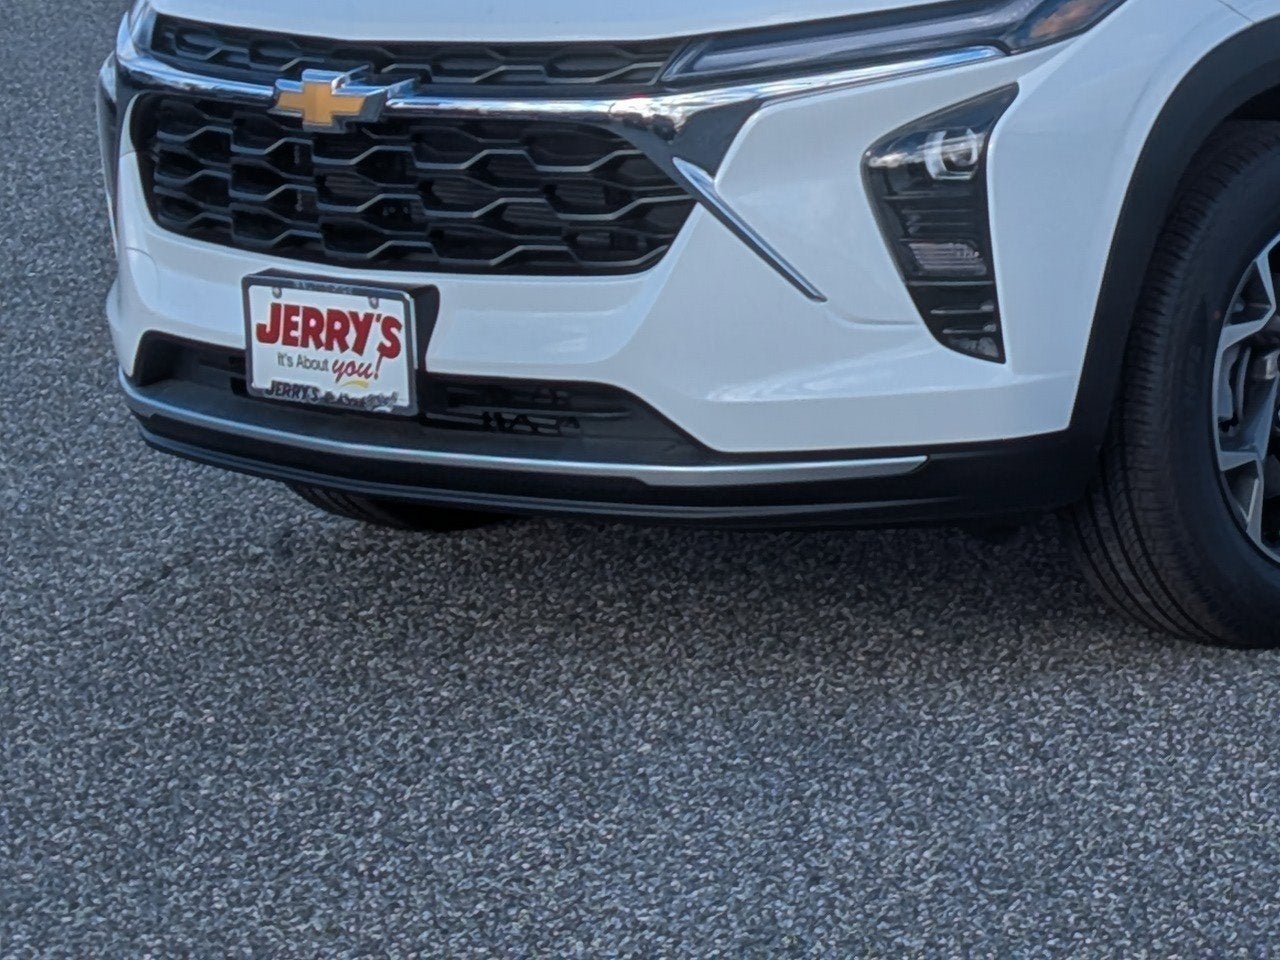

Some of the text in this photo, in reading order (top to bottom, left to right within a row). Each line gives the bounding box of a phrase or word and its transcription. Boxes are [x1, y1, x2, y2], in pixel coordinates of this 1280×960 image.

[256, 302, 403, 359] JERRY'S
[277, 351, 384, 383] It's About you!
